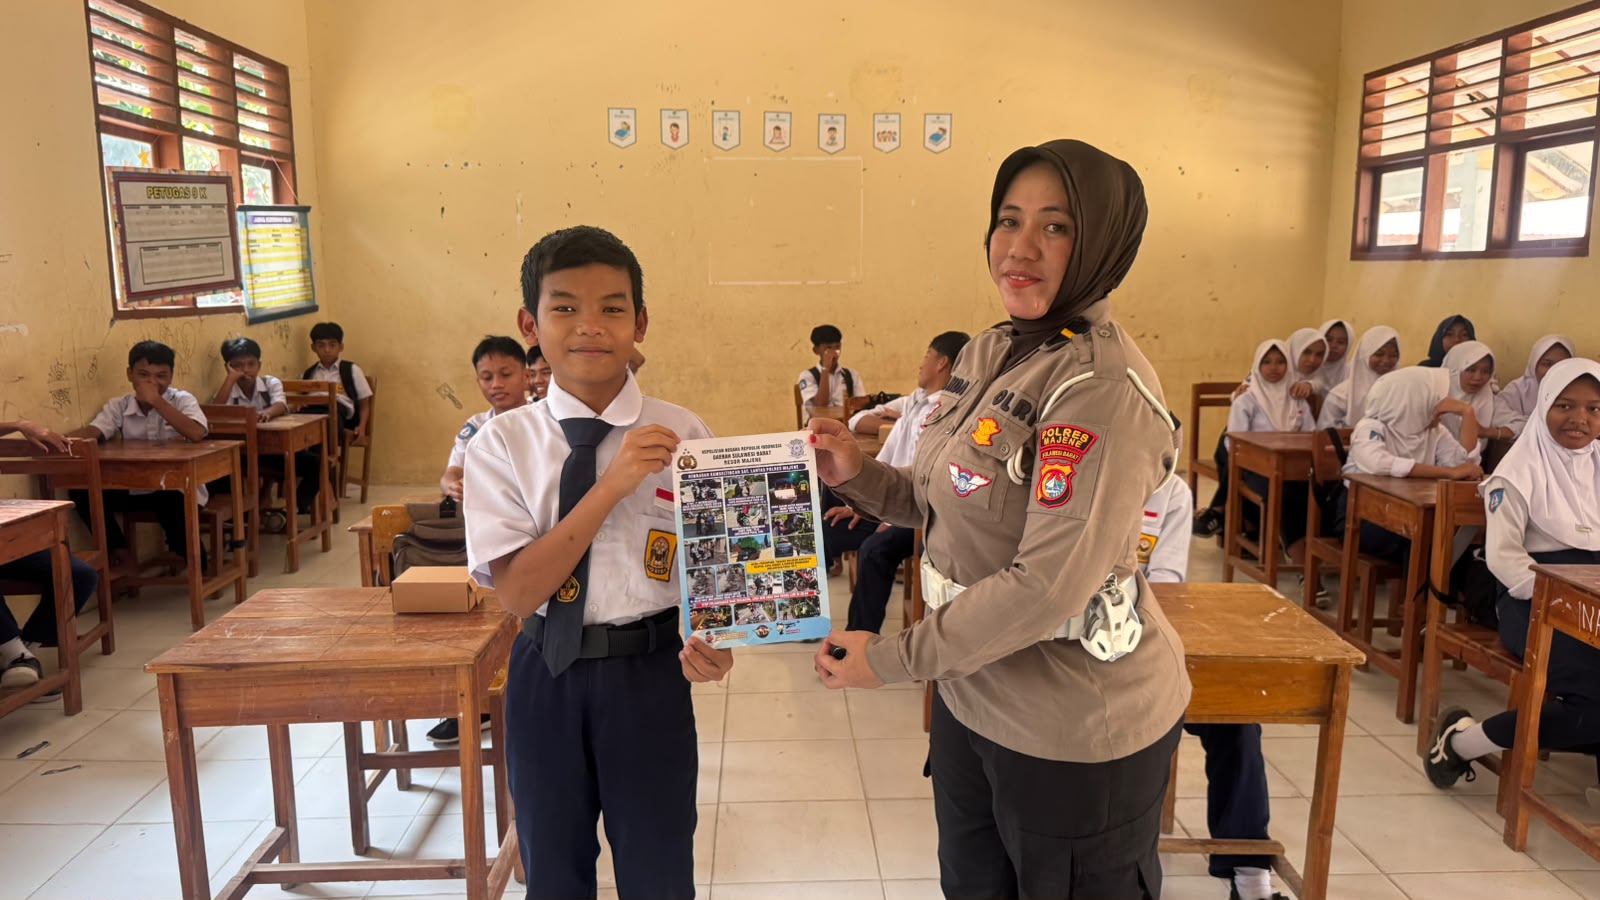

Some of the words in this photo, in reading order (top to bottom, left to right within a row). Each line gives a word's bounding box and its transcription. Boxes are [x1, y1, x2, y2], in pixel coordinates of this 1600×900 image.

[146, 185, 191, 199] PETUGAS
[199, 186, 208, 199] K
[1042, 427, 1090, 443] POLRES
[1043, 436, 1083, 448] MAJENE
[732, 451, 756, 459] SULAWESI
[1062, 450, 1080, 461] BARAT
